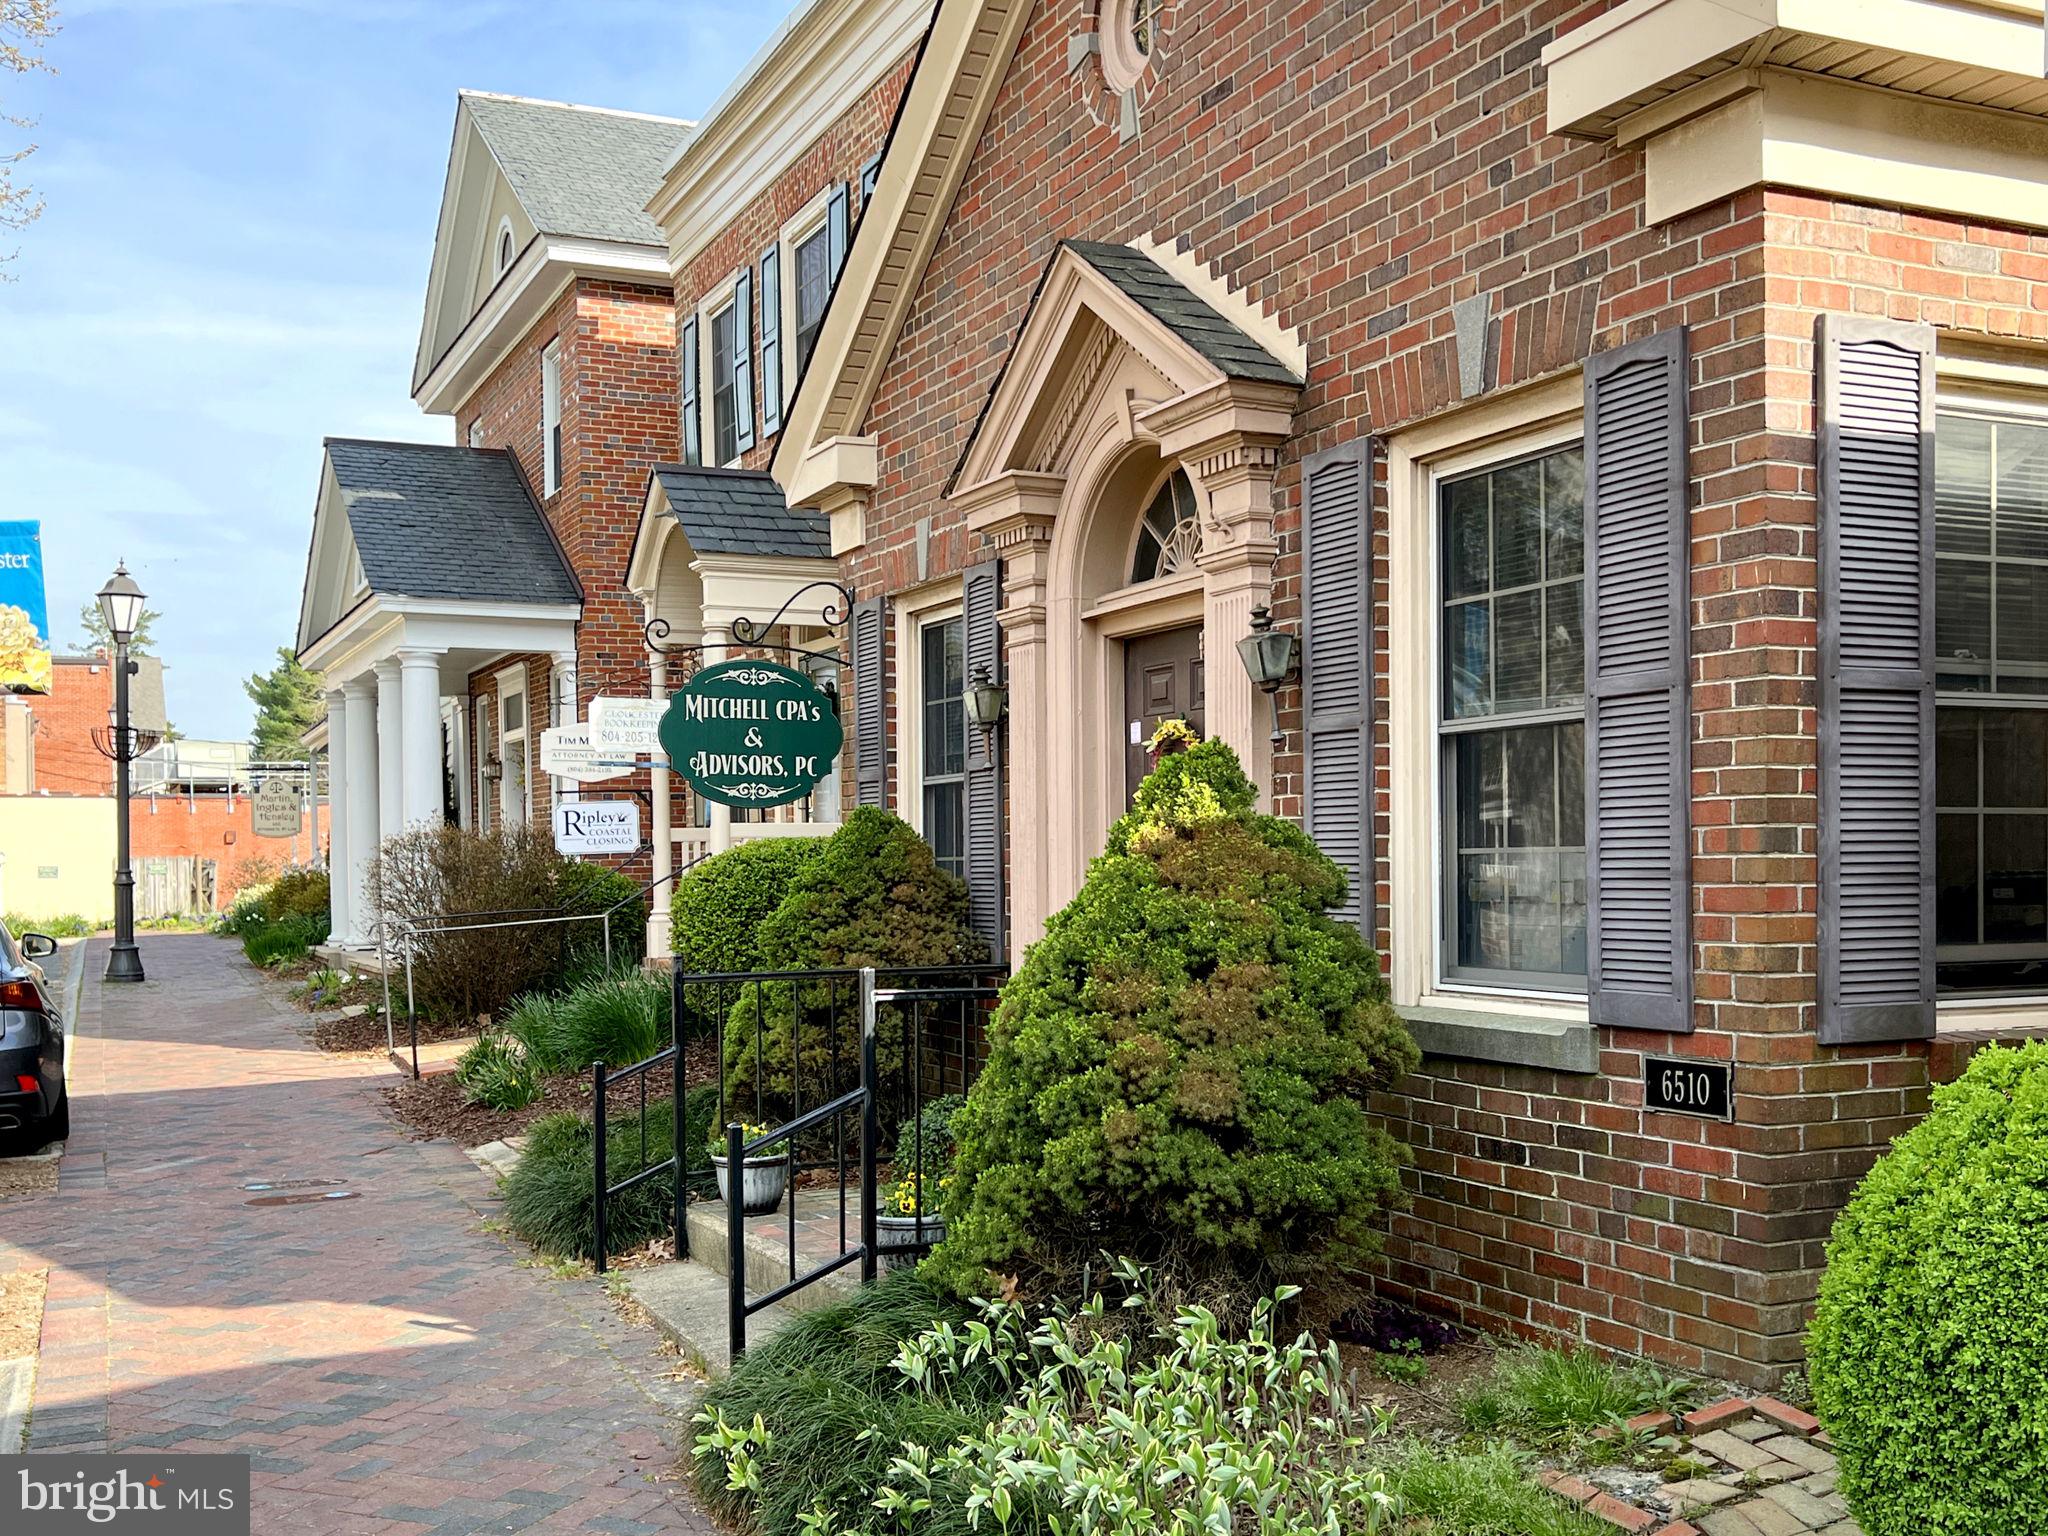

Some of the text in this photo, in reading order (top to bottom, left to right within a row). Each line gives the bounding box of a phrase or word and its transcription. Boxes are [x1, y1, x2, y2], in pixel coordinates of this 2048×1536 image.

[604, 710, 663, 719] GLOUCESTE
[685, 693, 821, 723] MITCHELL CPA's
[557, 735, 576, 745] TIM
[744, 727, 763, 748] &
[689, 751, 818, 778] ADVISORS, PC
[563, 810, 616, 836] Ripley
[589, 827, 632, 836] COASTAL
[586, 837, 634, 846] CLOSINGS
[1662, 1069, 1710, 1105] 6510
